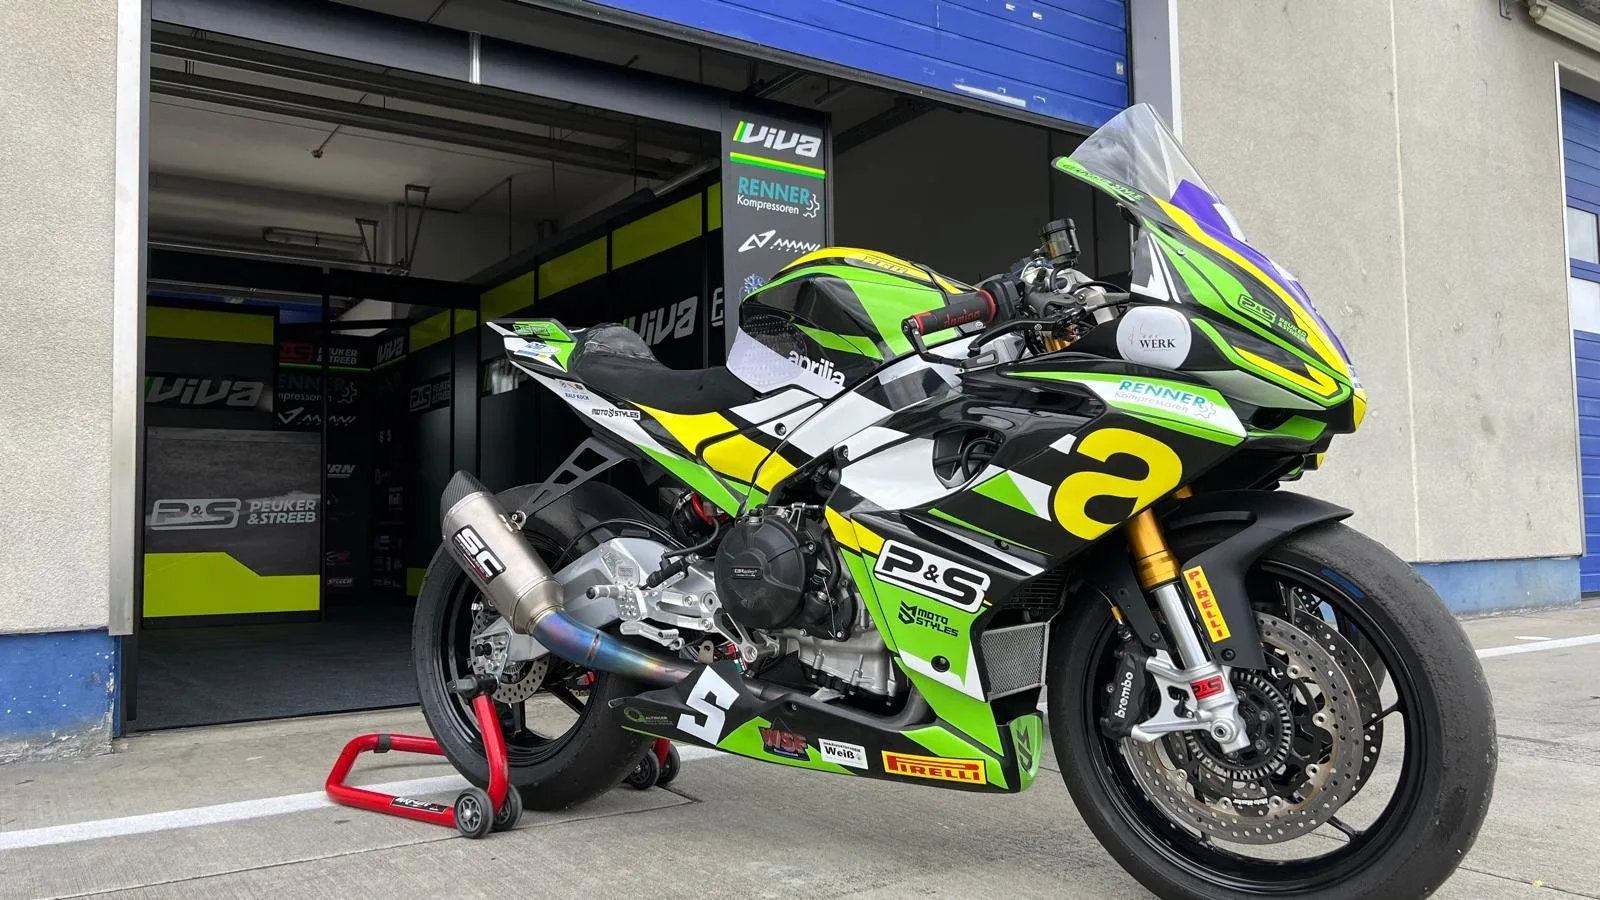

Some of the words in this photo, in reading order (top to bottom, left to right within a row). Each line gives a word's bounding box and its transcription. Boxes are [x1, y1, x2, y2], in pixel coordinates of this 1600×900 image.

[738, 176, 810, 205] RENNER
[737, 193, 800, 215] Kompressoren
[1140, 338, 1176, 349] WERK
[1118, 380, 1206, 408] RENNER
[614, 410, 639, 418] STYLES
[152, 499, 240, 528] P&S
[247, 511, 316, 525] &STREEB
[250, 500, 316, 512] PEUKER
[456, 527, 503, 577] SC
[878, 541, 987, 609] P&S
[917, 608, 948, 625] MOTO
[1188, 570, 1223, 638] PIRELLI
[916, 616, 959, 637] STYLES
[1114, 670, 1134, 719] brembo
[824, 745, 855, 759] Weiß
[886, 754, 980, 782] PIRELLI
